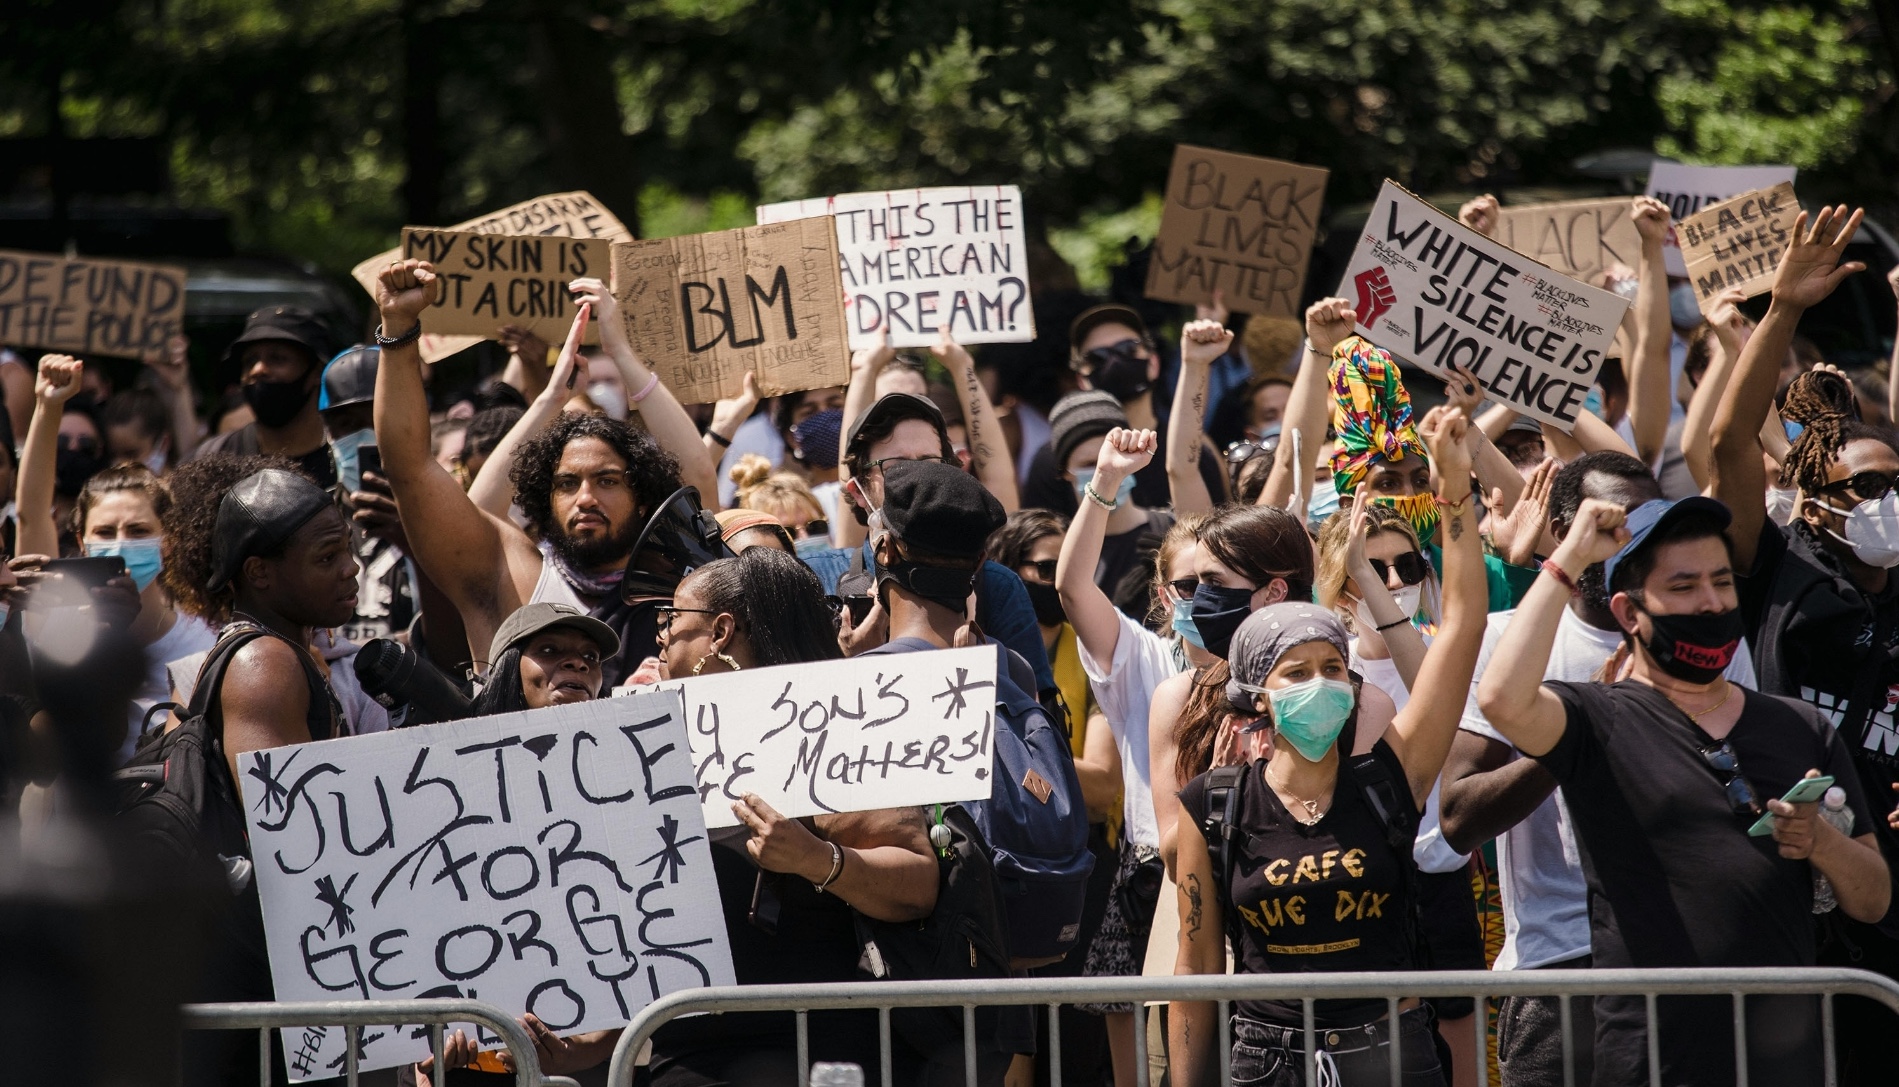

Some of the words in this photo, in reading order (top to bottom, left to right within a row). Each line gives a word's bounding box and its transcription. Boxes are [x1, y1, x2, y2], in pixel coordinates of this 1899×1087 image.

[836, 202, 936, 245] THIS
[941, 198, 1014, 236] THE
[1175, 158, 1321, 230] BLACK
[1685, 191, 1786, 247] BLACK
[407, 231, 458, 265] MY
[463, 236, 542, 273] SKIN
[559, 241, 588, 277] IS
[838, 242, 1011, 287] AMERICAN
[1195, 211, 1302, 266] LIVES
[1385, 200, 1521, 304] WHITE
[1507, 206, 1627, 272] LACK
[1711, 218, 1787, 262] LIVES
[0, 259, 179, 314] DEFUND
[432, 273, 471, 309] OT
[473, 282, 500, 319] A
[1151, 241, 1299, 314] MATTER
[1697, 242, 1790, 299] MATTE
[0, 302, 80, 347] THE
[680, 265, 798, 354] BLM
[855, 276, 1027, 336] DREAM?
[1420, 274, 1567, 362] SILENCE
[1559, 343, 1601, 375] IS
[1531, 290, 1568, 312] MATTER
[1414, 305, 1590, 424] VIOLENCE
[1679, 643, 1719, 667] New
[372, 816, 634, 909] FOR
[1264, 848, 1367, 886] CAFE
[1335, 890, 1390, 922] DIX
[299, 881, 713, 1000] GEORGE
